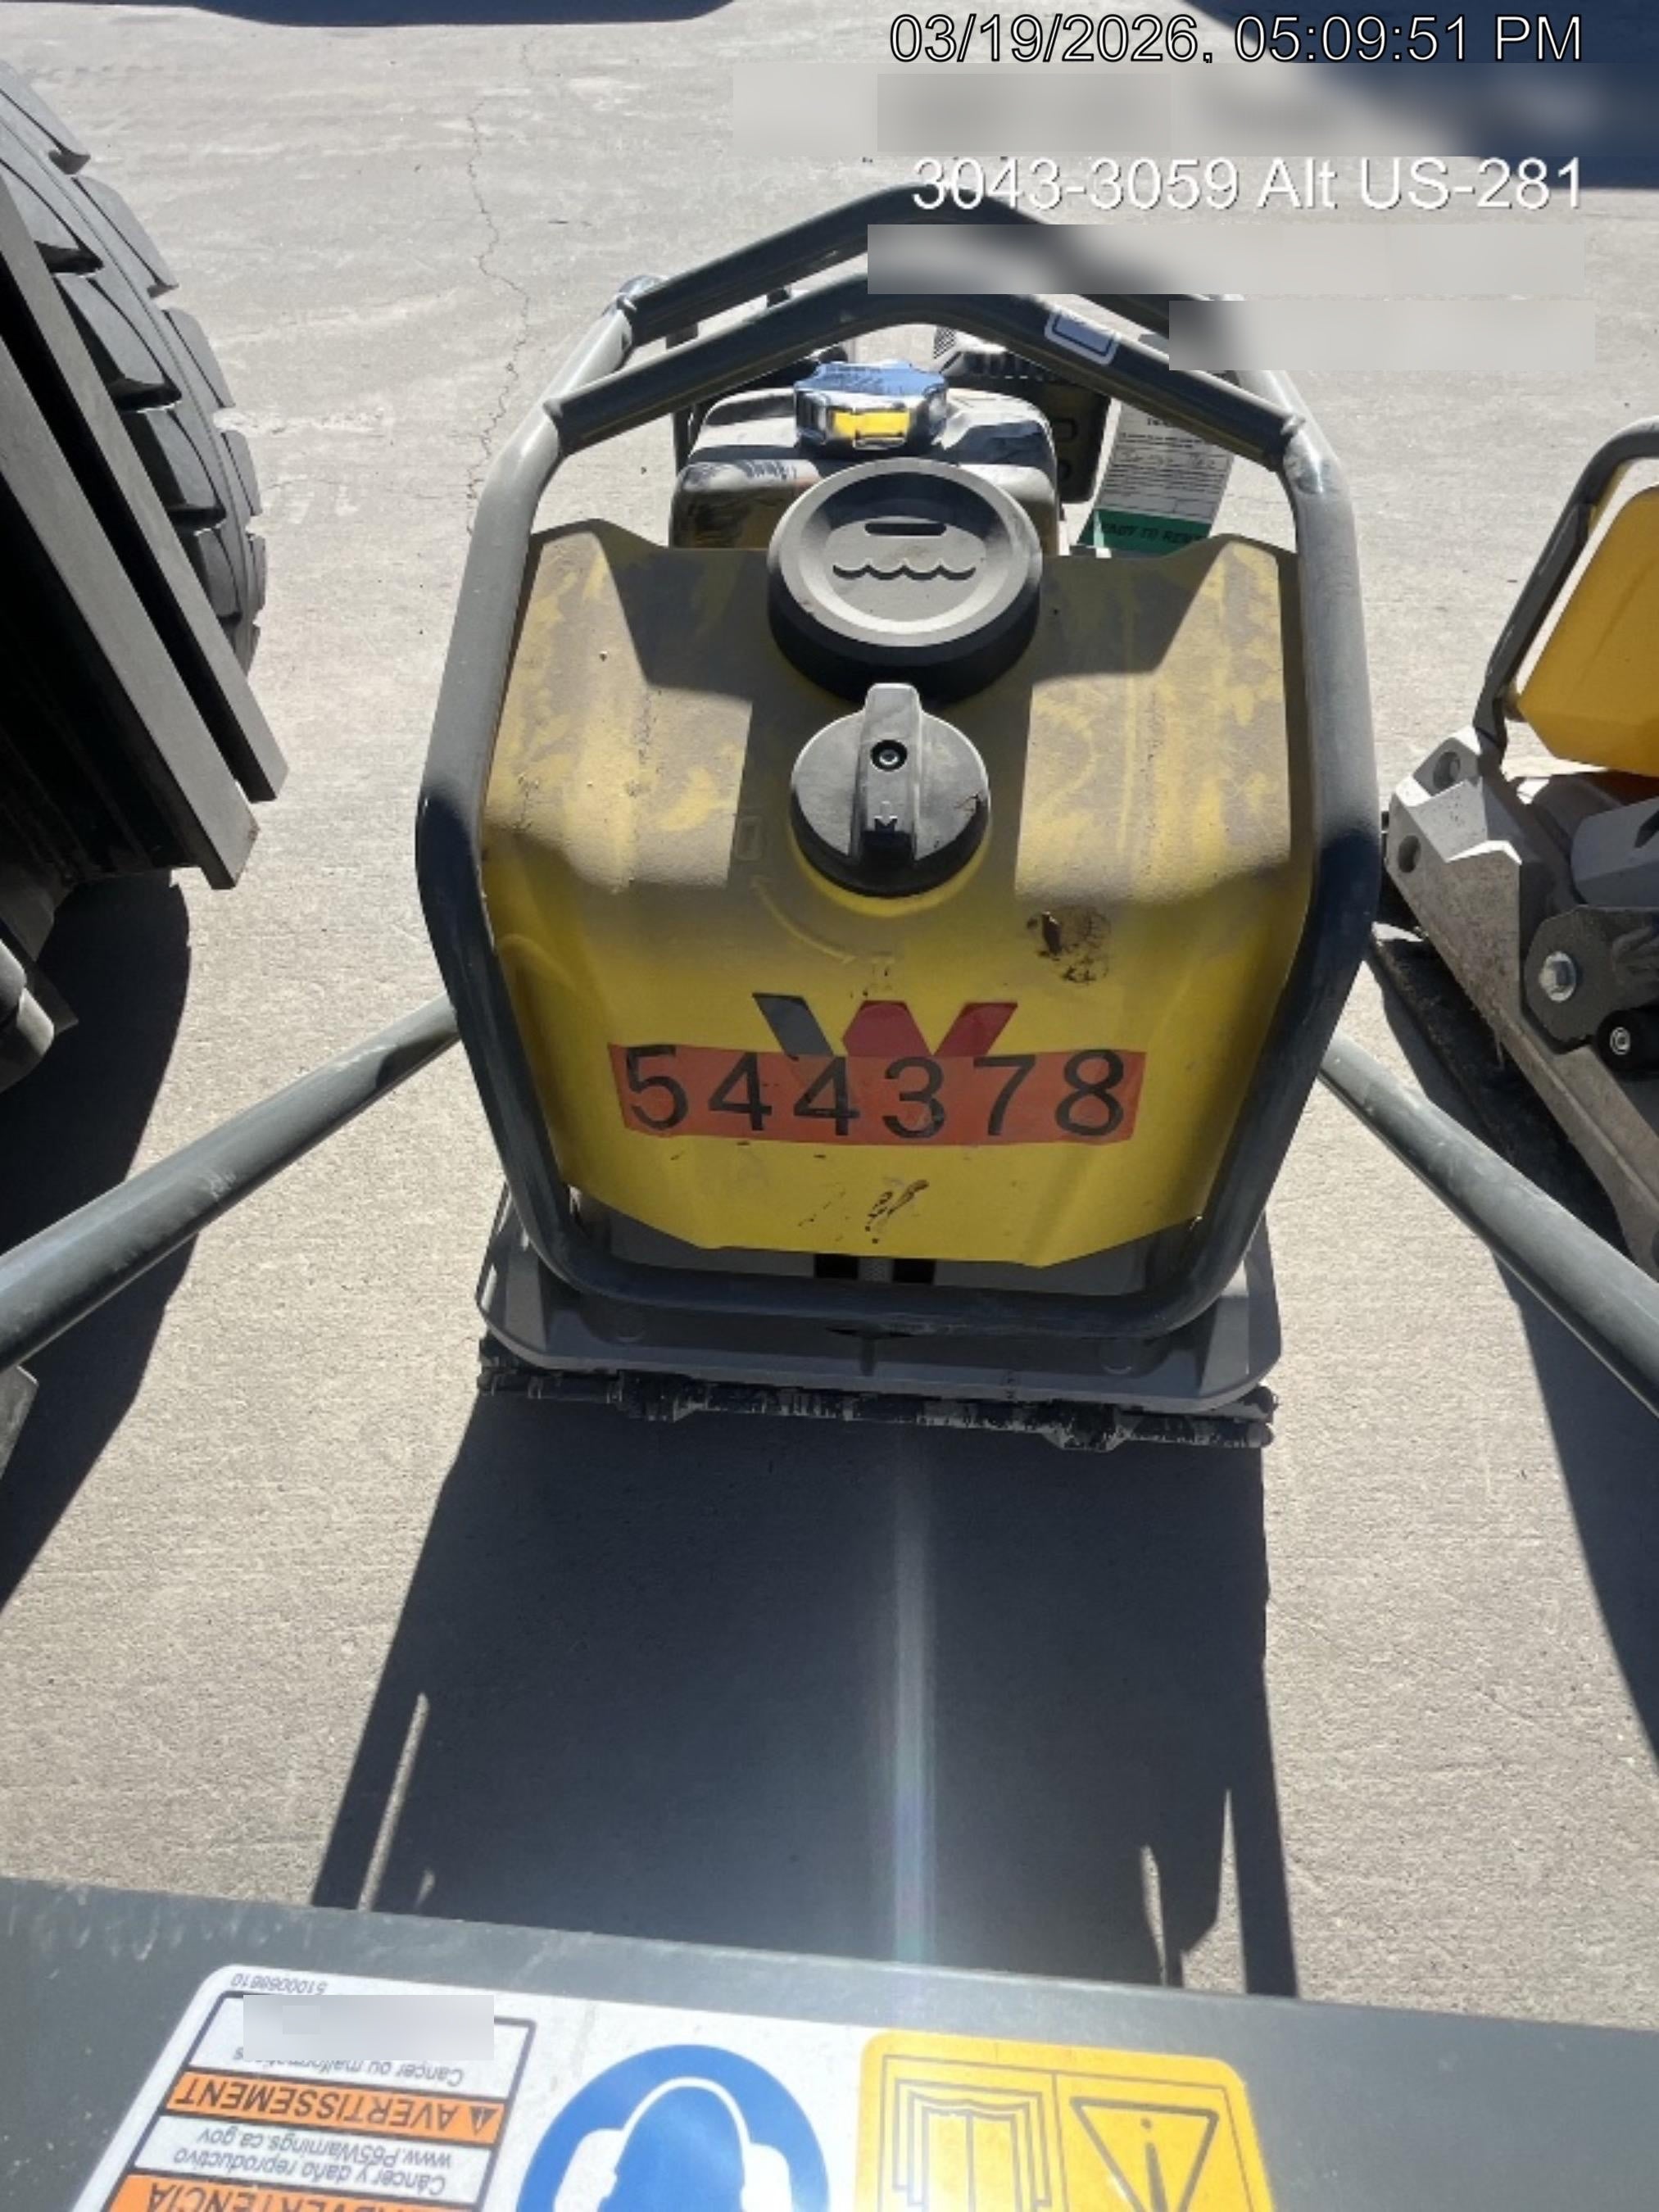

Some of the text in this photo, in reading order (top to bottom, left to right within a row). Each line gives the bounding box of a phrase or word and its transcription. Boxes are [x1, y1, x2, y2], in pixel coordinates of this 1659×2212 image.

[624, 1045, 1125, 1139] 544378
[175, 2077, 458, 2131] AVERTISSEMENT
[174, 2147, 297, 2176] reproductivo
[197, 2126, 452, 2169] www.P65Warnings.ca.gov
[351, 2167, 369, 2185] y
